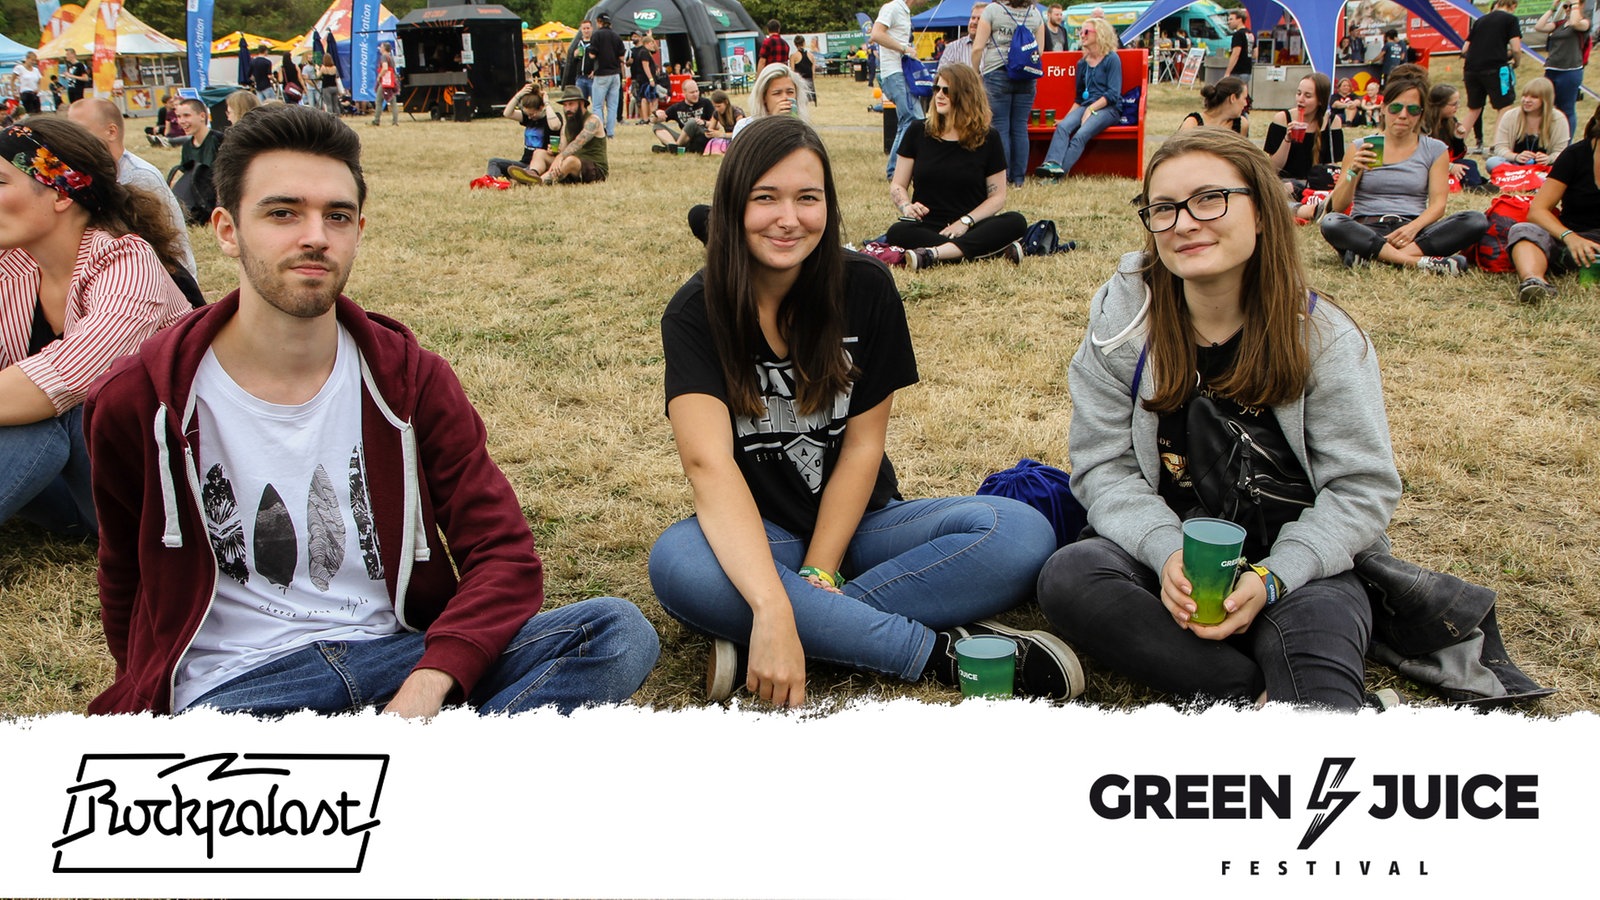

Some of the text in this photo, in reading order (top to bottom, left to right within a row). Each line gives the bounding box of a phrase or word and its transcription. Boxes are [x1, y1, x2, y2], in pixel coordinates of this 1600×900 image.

[633, 11, 656, 20] VRS
[360, 4, 372, 96] Powerbank-Station
[1047, 65, 1066, 77] För
